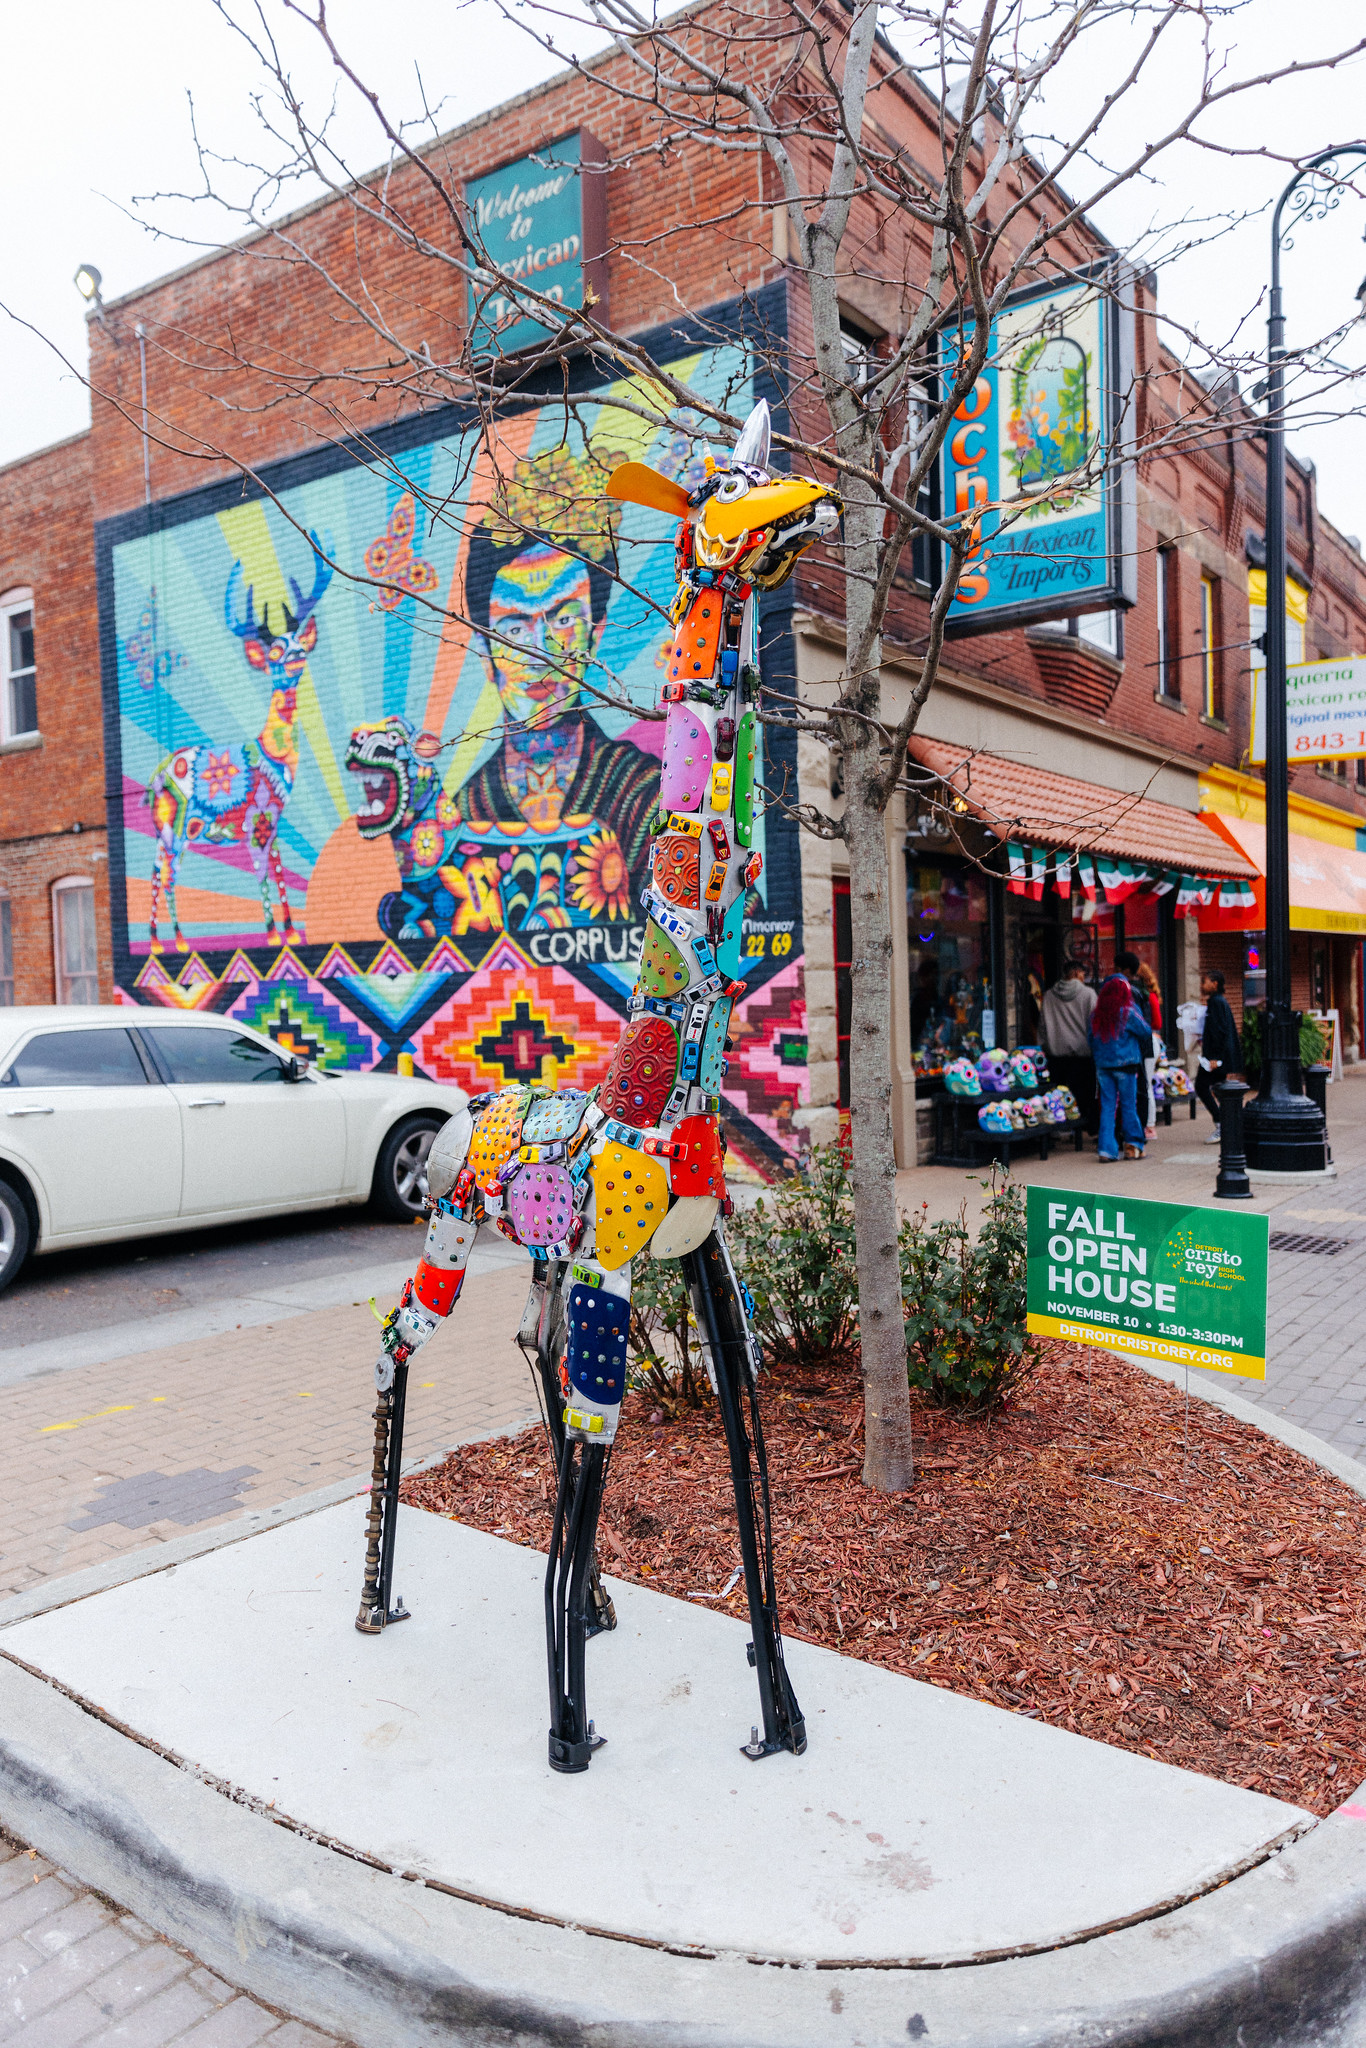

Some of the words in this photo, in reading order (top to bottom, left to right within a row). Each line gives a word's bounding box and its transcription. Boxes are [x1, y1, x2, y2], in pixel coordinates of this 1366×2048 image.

[475, 172, 575, 229] Welcome
[505, 212, 534, 242] to
[991, 527, 1097, 567] Mexican
[999, 557, 1092, 593] Imports
[1286, 668, 1353, 690] queria
[1286, 692, 1343, 708] exican
[1287, 710, 1330, 727] iginal
[530, 926, 644, 963] CORPUS
[746, 934, 766, 957] 22
[771, 933, 792, 957] 69
[1048, 1202, 1136, 1241] FALL
[1047, 1234, 1147, 1275] OPEN
[1185, 1248, 1242, 1266] cristo
[1195, 1244, 1223, 1253] DETROIT
[1185, 1261, 1218, 1279] rey
[1218, 1272, 1246, 1282] SCHOOL
[1048, 1264, 1176, 1313] HOUSE
[1047, 1301, 1120, 1325] NOVEMBER
[1123, 1315, 1139, 1328] 10
[1158, 1322, 1244, 1348] 1:30-3:30PM
[1059, 1323, 1234, 1368] DETROITCRISTOREY.ORG
